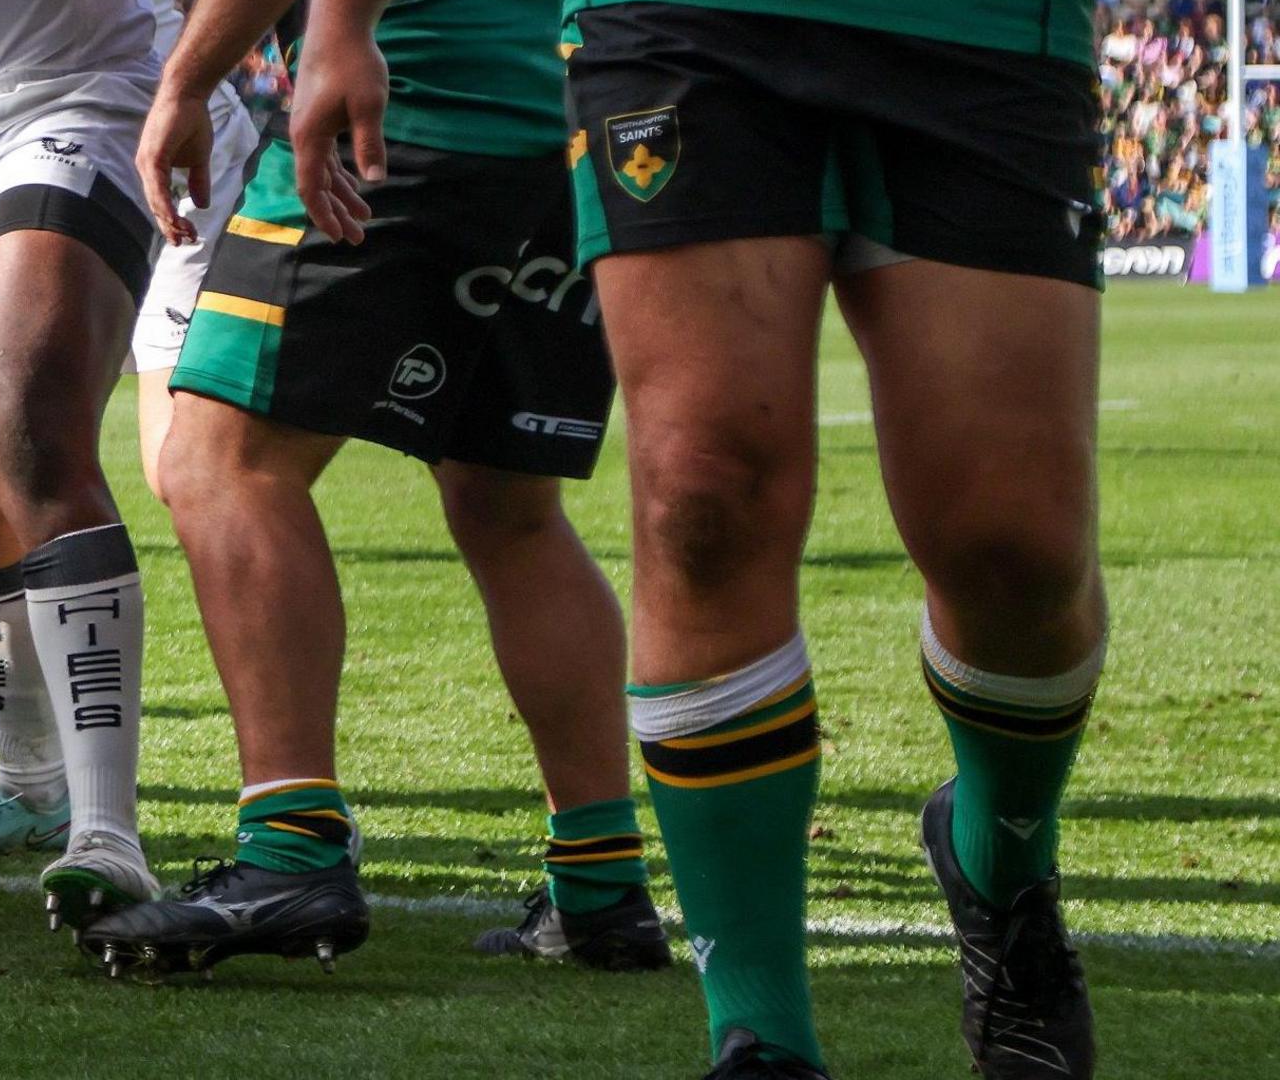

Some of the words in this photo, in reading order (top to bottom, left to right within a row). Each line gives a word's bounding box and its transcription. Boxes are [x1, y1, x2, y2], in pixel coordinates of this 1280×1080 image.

[619, 125, 664, 143] SAINTS
[511, 411, 557, 435] GT
[57, 587, 122, 732] HIEFS
